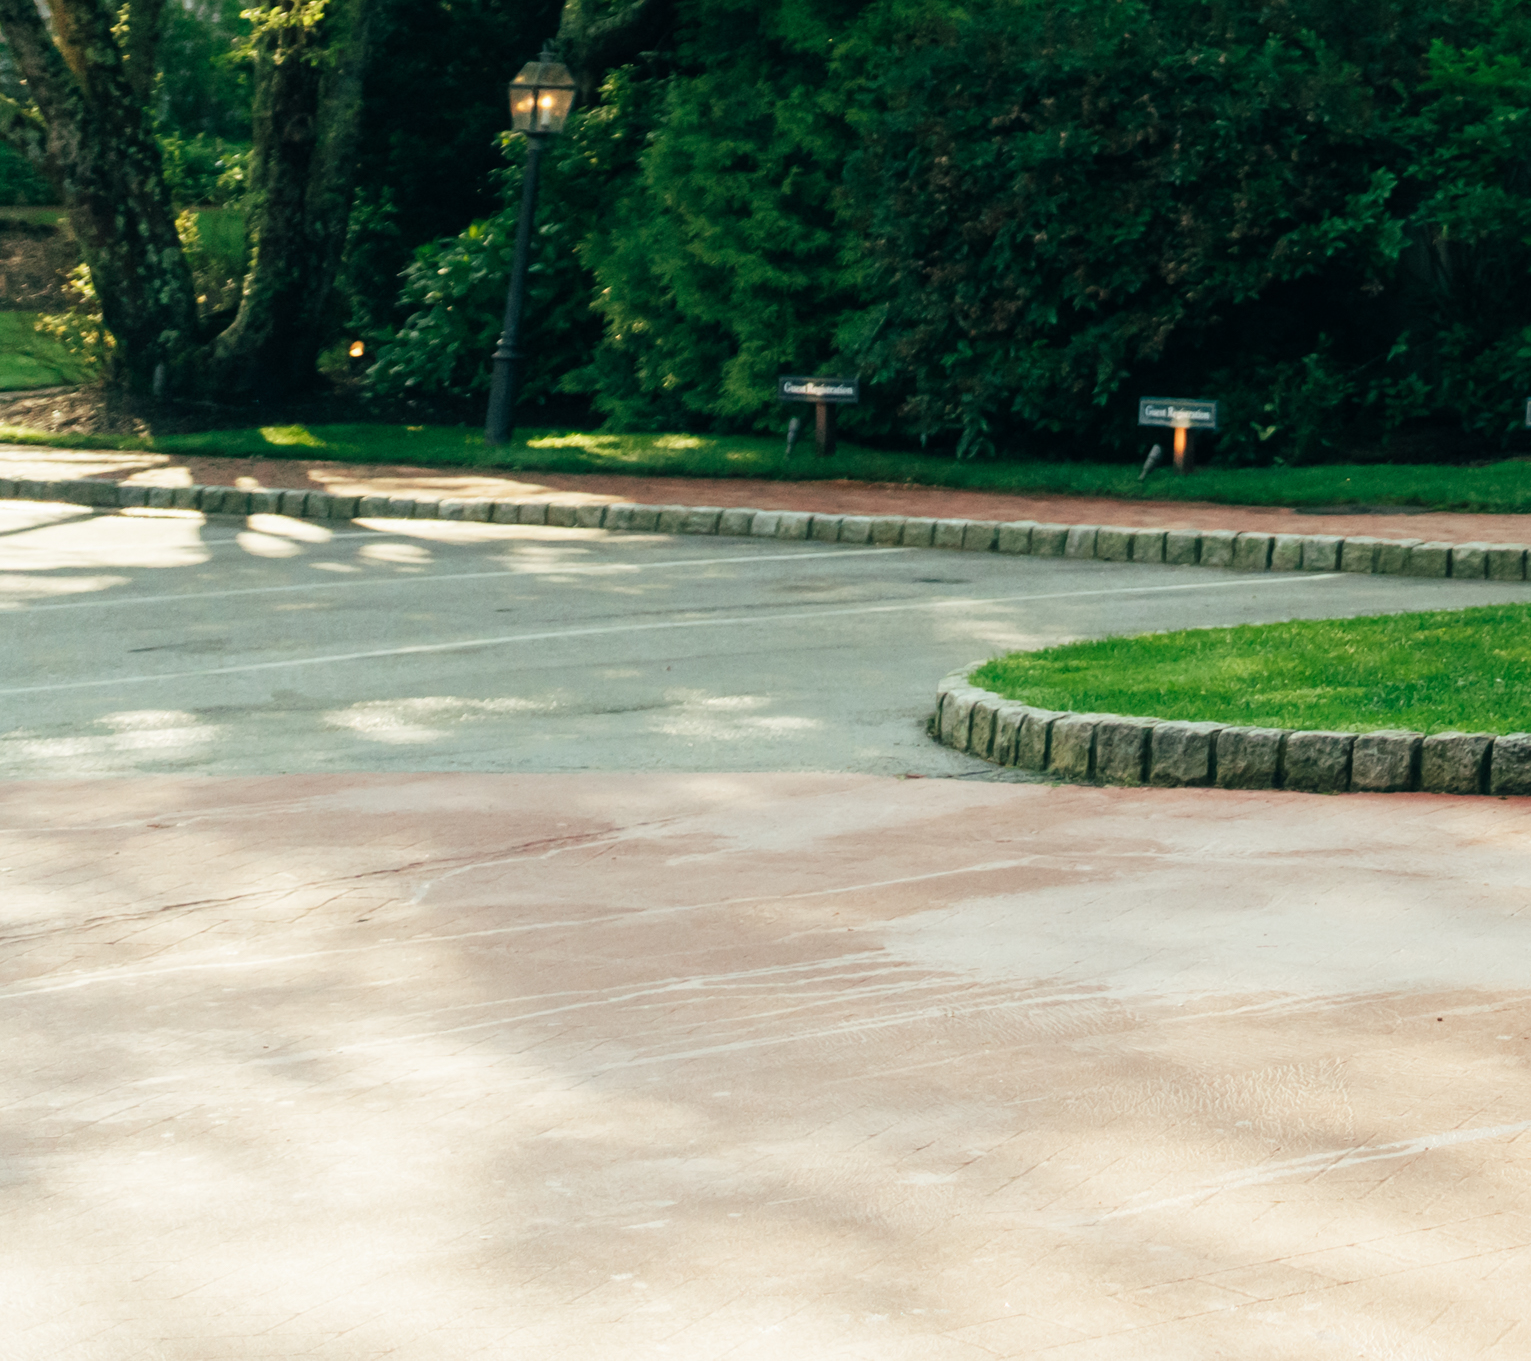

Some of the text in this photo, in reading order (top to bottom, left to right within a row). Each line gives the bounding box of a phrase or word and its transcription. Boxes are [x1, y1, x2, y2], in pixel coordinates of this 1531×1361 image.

[784, 381, 853, 396] Guest Registration
[1145, 405, 1166, 417] Guest
